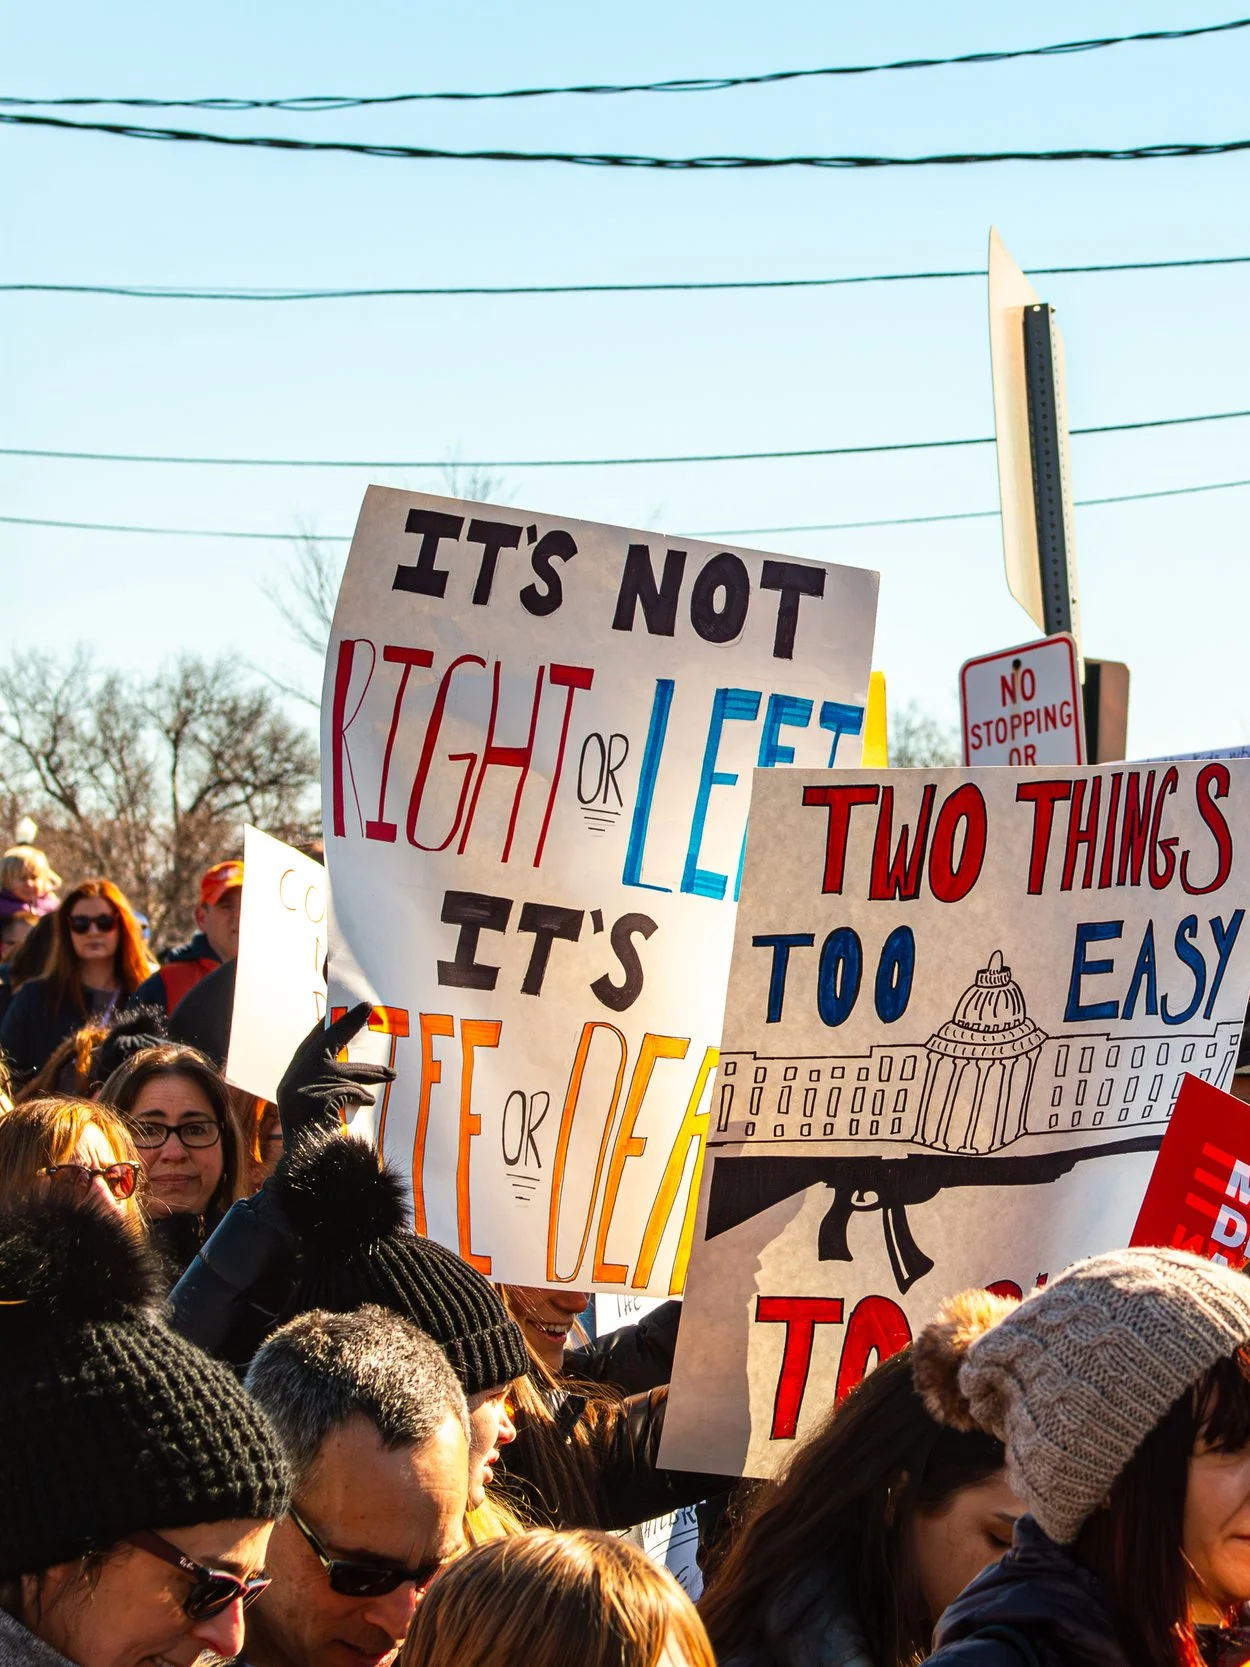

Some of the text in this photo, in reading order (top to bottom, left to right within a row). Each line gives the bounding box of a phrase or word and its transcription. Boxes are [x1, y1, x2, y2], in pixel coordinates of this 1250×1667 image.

[392, 508, 827, 660] IT'S NOT
[970, 701, 1072, 751] STOPPING
[1000, 668, 1036, 707] NO
[333, 638, 595, 868] RIGHT
[576, 733, 630, 808] OR
[1009, 744, 1037, 767] OR
[802, 763, 1232, 904] TWO THINGS
[437, 890, 658, 1012] IT'S
[752, 908, 1246, 1027] TOO EASY
[502, 1090, 550, 1168] OR
